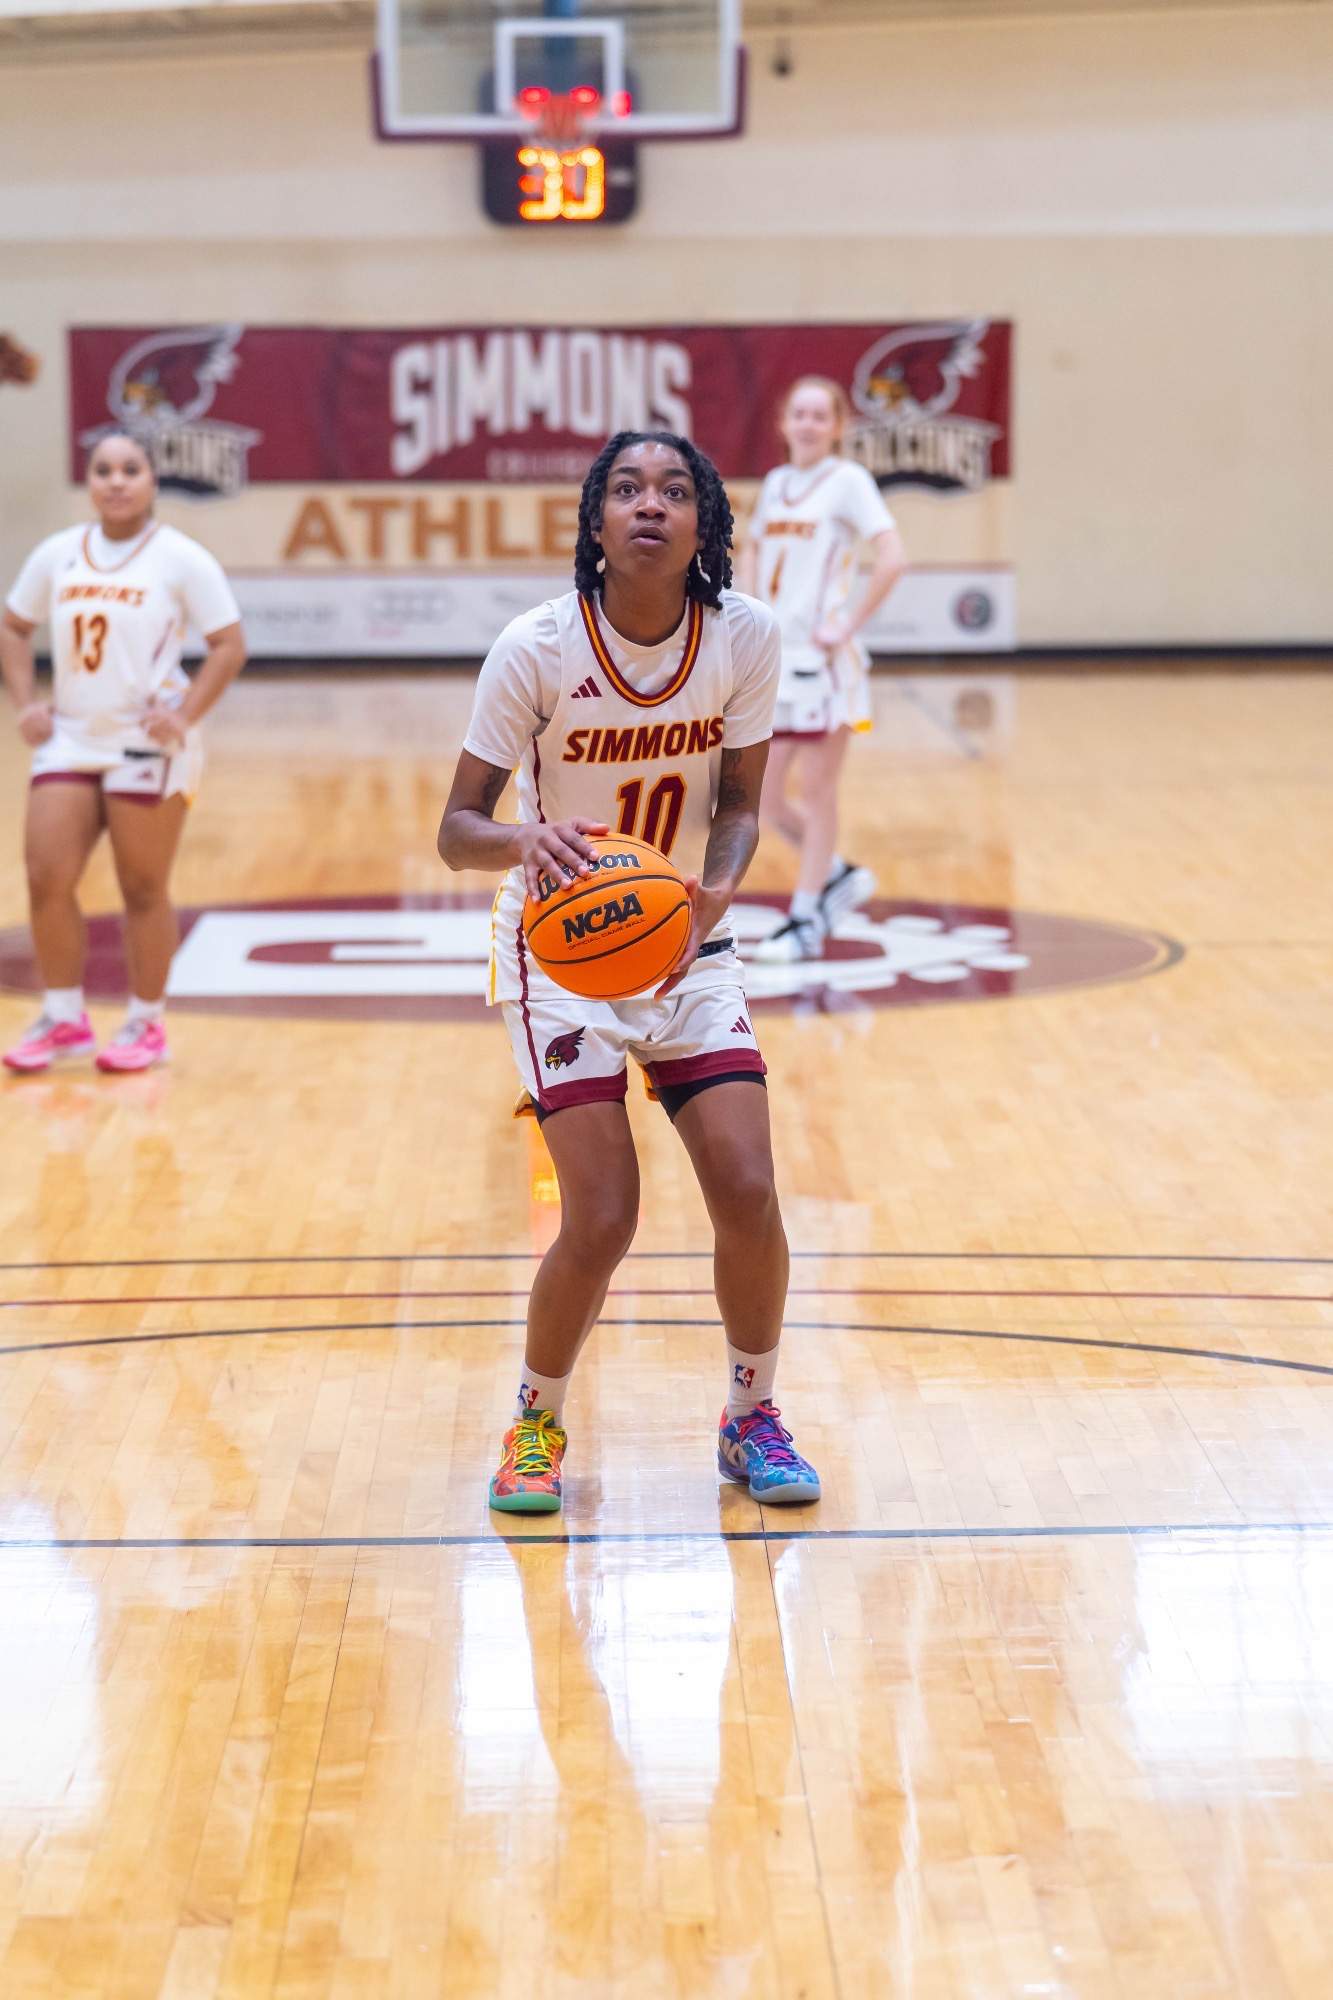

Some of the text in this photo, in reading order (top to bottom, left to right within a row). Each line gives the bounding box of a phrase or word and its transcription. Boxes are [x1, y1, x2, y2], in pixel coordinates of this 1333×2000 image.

[516, 147, 605, 220] 30
[389, 331, 693, 476] SIMMONS
[282, 496, 577, 559] ATHLE
[72, 612, 109, 674] 13
[562, 715, 724, 764] SIMMONS
[616, 773, 688, 858] 10
[562, 892, 644, 943] NCAA
[567, 918, 646, 951] OFFICIAL GAME BALL
